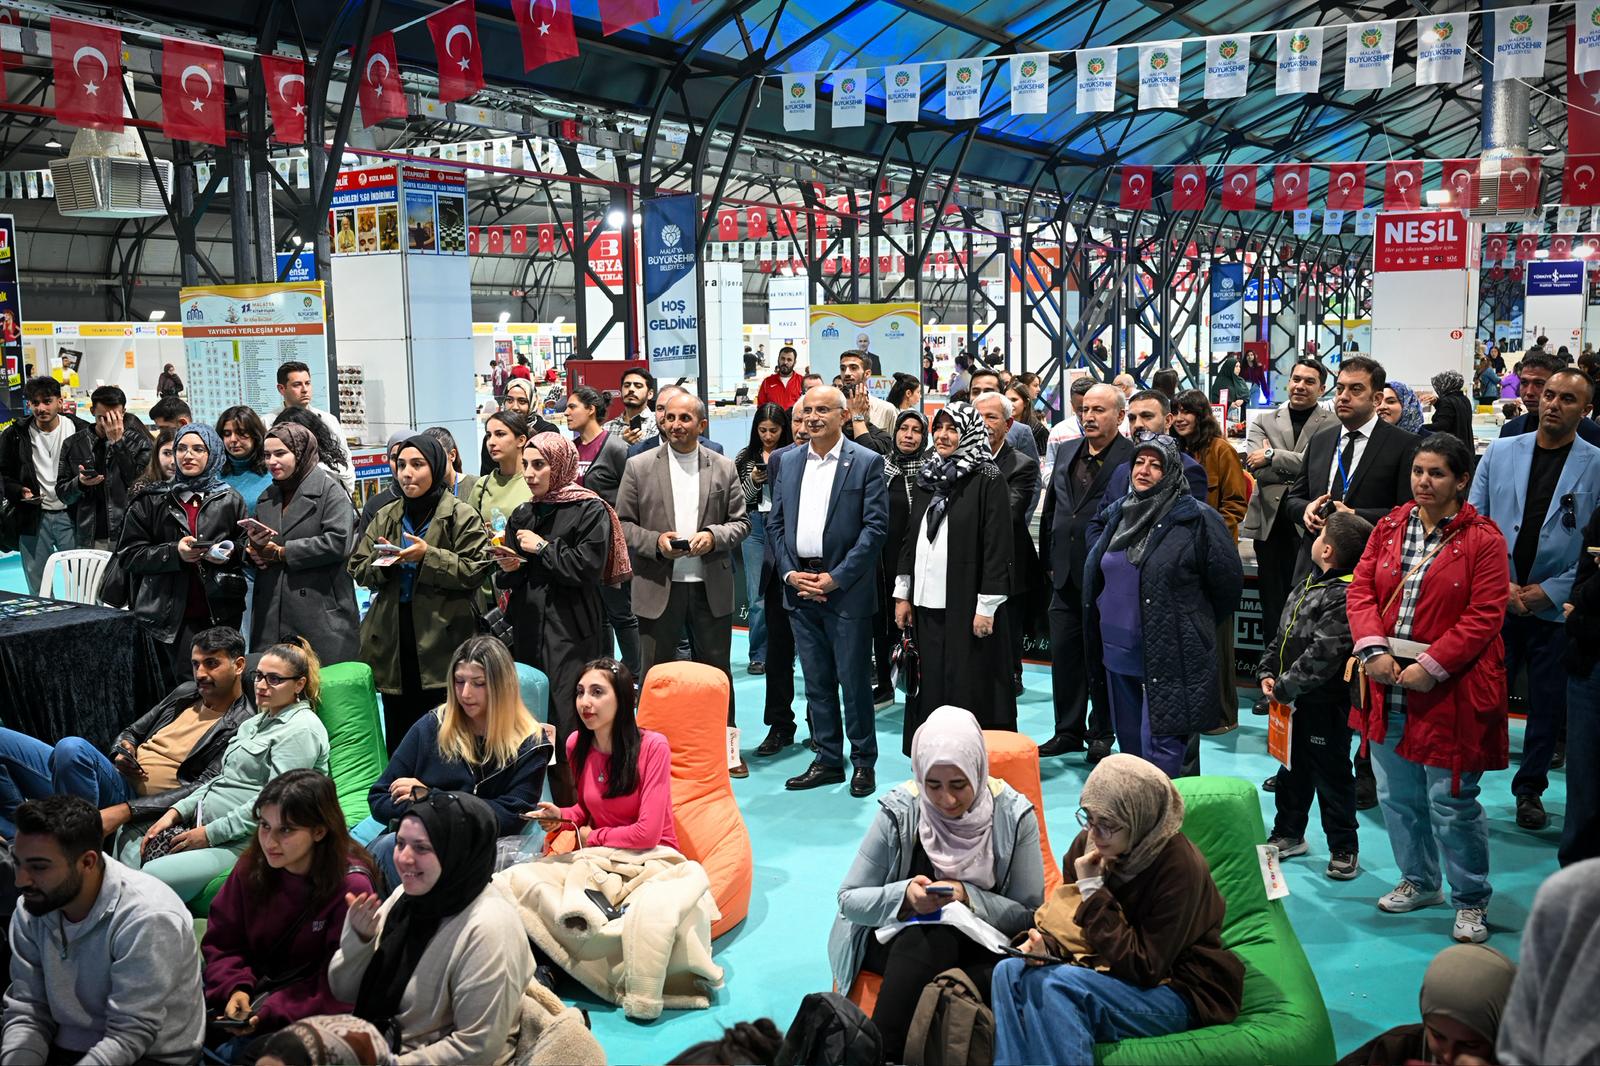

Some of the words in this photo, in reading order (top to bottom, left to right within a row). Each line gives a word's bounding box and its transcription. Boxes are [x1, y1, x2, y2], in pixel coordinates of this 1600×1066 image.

[380, 173, 394, 181] PANDA
[371, 190, 395, 200] İNDİRİMLE
[660, 247, 684, 255] MALATYA
[648, 253, 695, 265] BÜYÜKŞEHİR
[588, 258, 623, 272] BEYA
[289, 267, 309, 276] ensar
[661, 300, 686, 313] HOŞ
[649, 315, 697, 331] GELDİNİZ
[1212, 322, 1241, 330] GELDİNİZ
[238, 327, 273, 337] YERLEŞİM
[275, 326, 296, 334] PLANI
[682, 344, 697, 356] ER
[352, 455, 373, 465] TAPKOLİK
[361, 468, 382, 476] KLASİKLERİ
[1239, 598, 1263, 611] İMA
[739, 604, 749, 620] İy
[1038, 638, 1049, 650] ki
